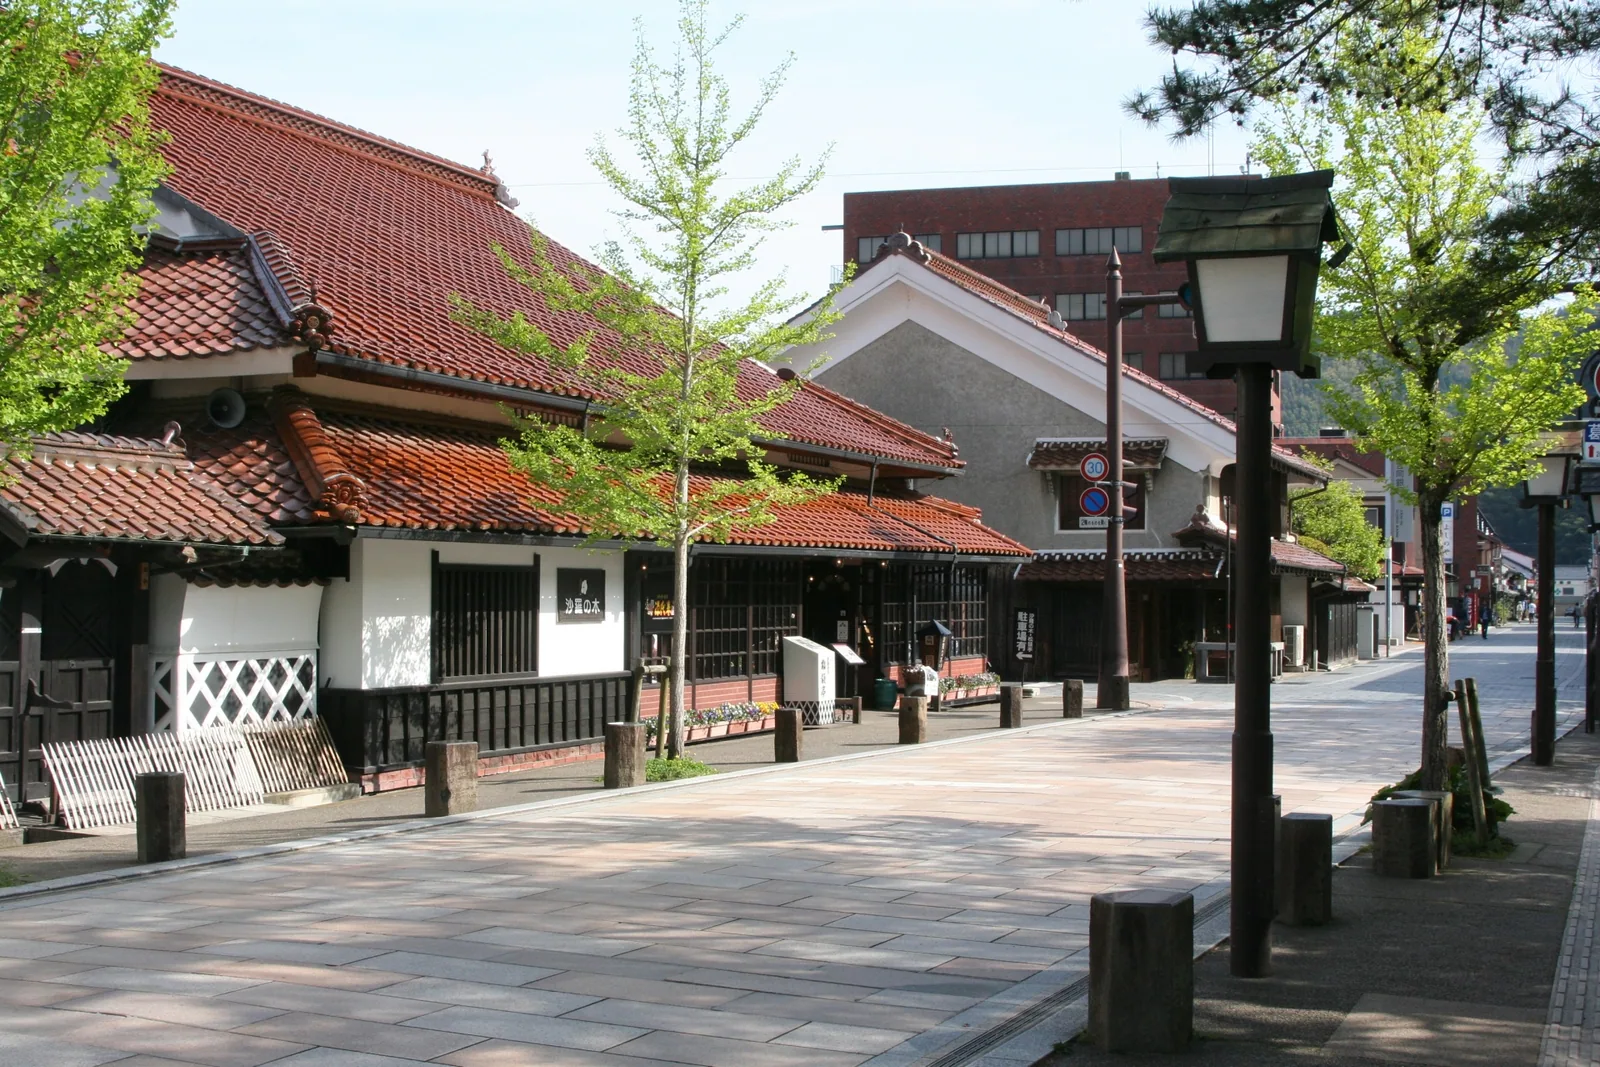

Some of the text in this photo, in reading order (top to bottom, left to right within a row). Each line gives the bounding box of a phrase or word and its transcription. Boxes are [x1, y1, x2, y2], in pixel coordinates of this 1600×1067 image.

[1087, 462, 1103, 474] 30
[565, 598, 600, 614] 沙羅の木
[1016, 611, 1028, 651] 駐車場有
